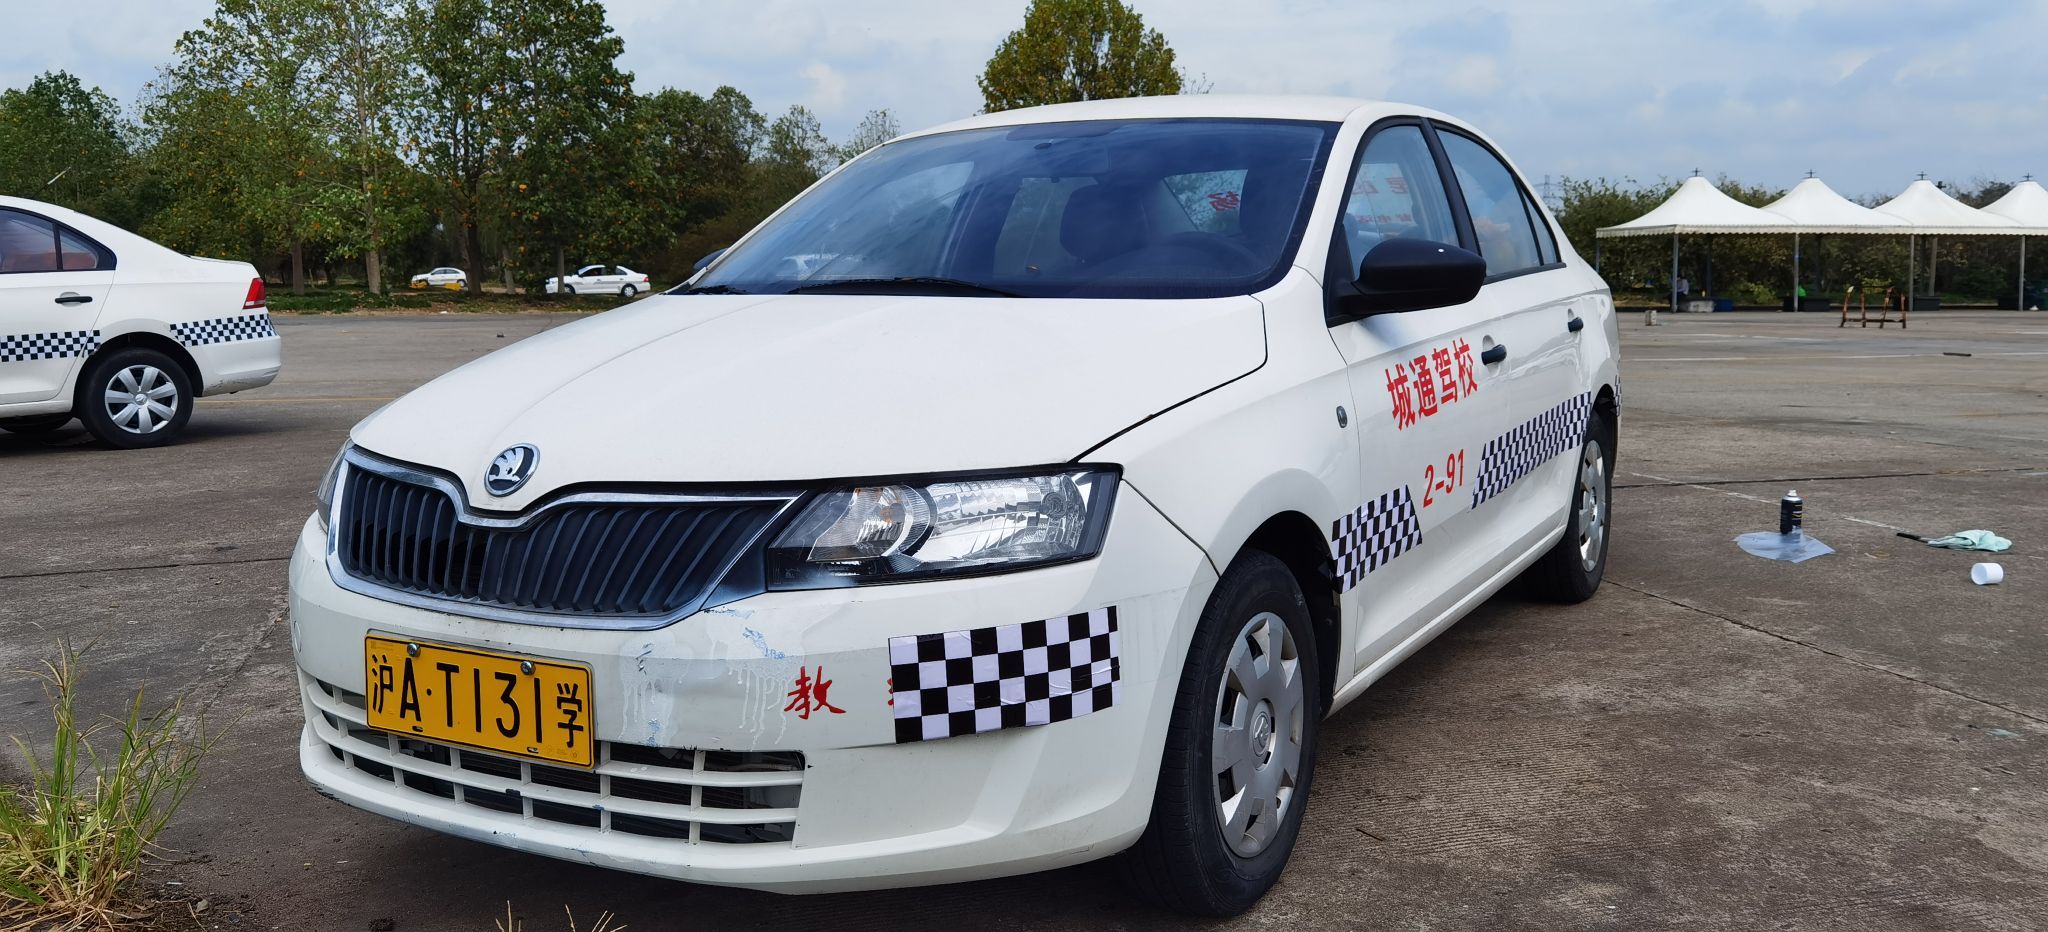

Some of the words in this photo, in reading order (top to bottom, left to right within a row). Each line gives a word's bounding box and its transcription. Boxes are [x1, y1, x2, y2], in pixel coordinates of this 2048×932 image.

[1385, 337, 1478, 431] 城通驾校
[1423, 448, 1465, 508] 2-91
[372, 654, 584, 748] 沪A·T131学
[785, 666, 846, 720] 教
